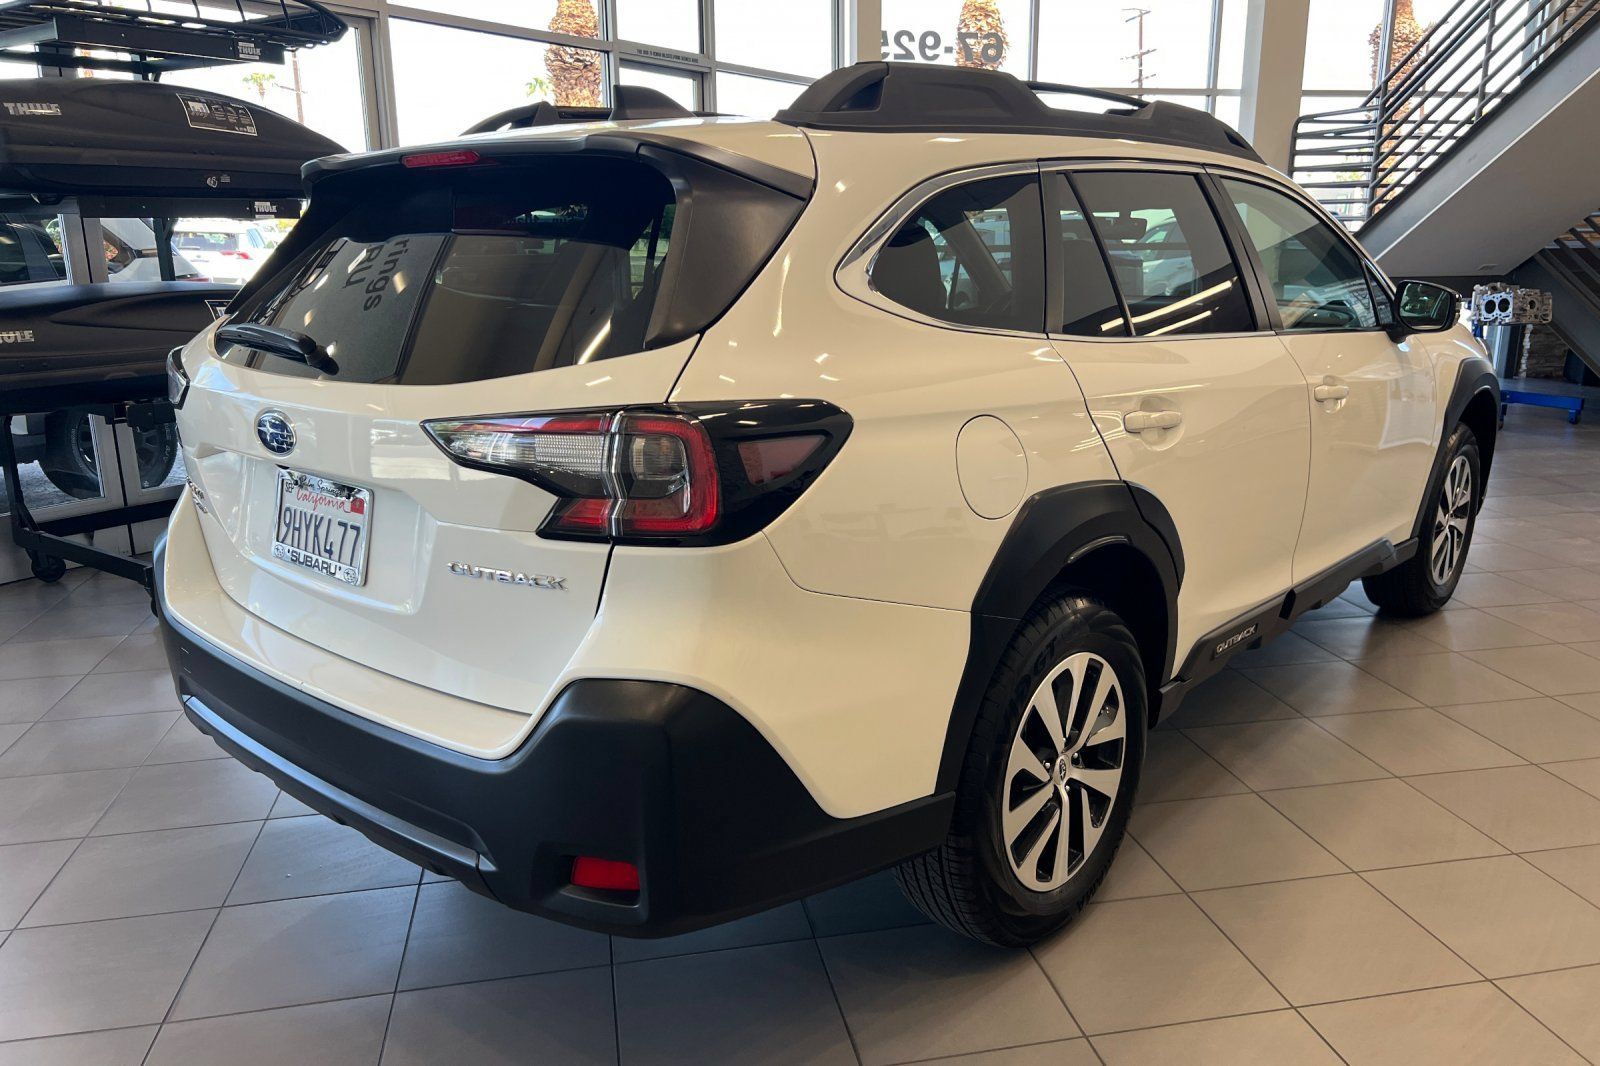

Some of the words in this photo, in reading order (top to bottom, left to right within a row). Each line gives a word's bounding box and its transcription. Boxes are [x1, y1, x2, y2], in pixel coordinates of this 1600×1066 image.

[254, 205, 277, 213] THULE
[363, 238, 410, 311] rings
[0, 330, 35, 344] ULE
[282, 507, 360, 567] 9HYK477
[290, 550, 338, 576] SUBARU
[447, 561, 569, 592] OUTBACK
[1216, 624, 1256, 653] OUTBACK
